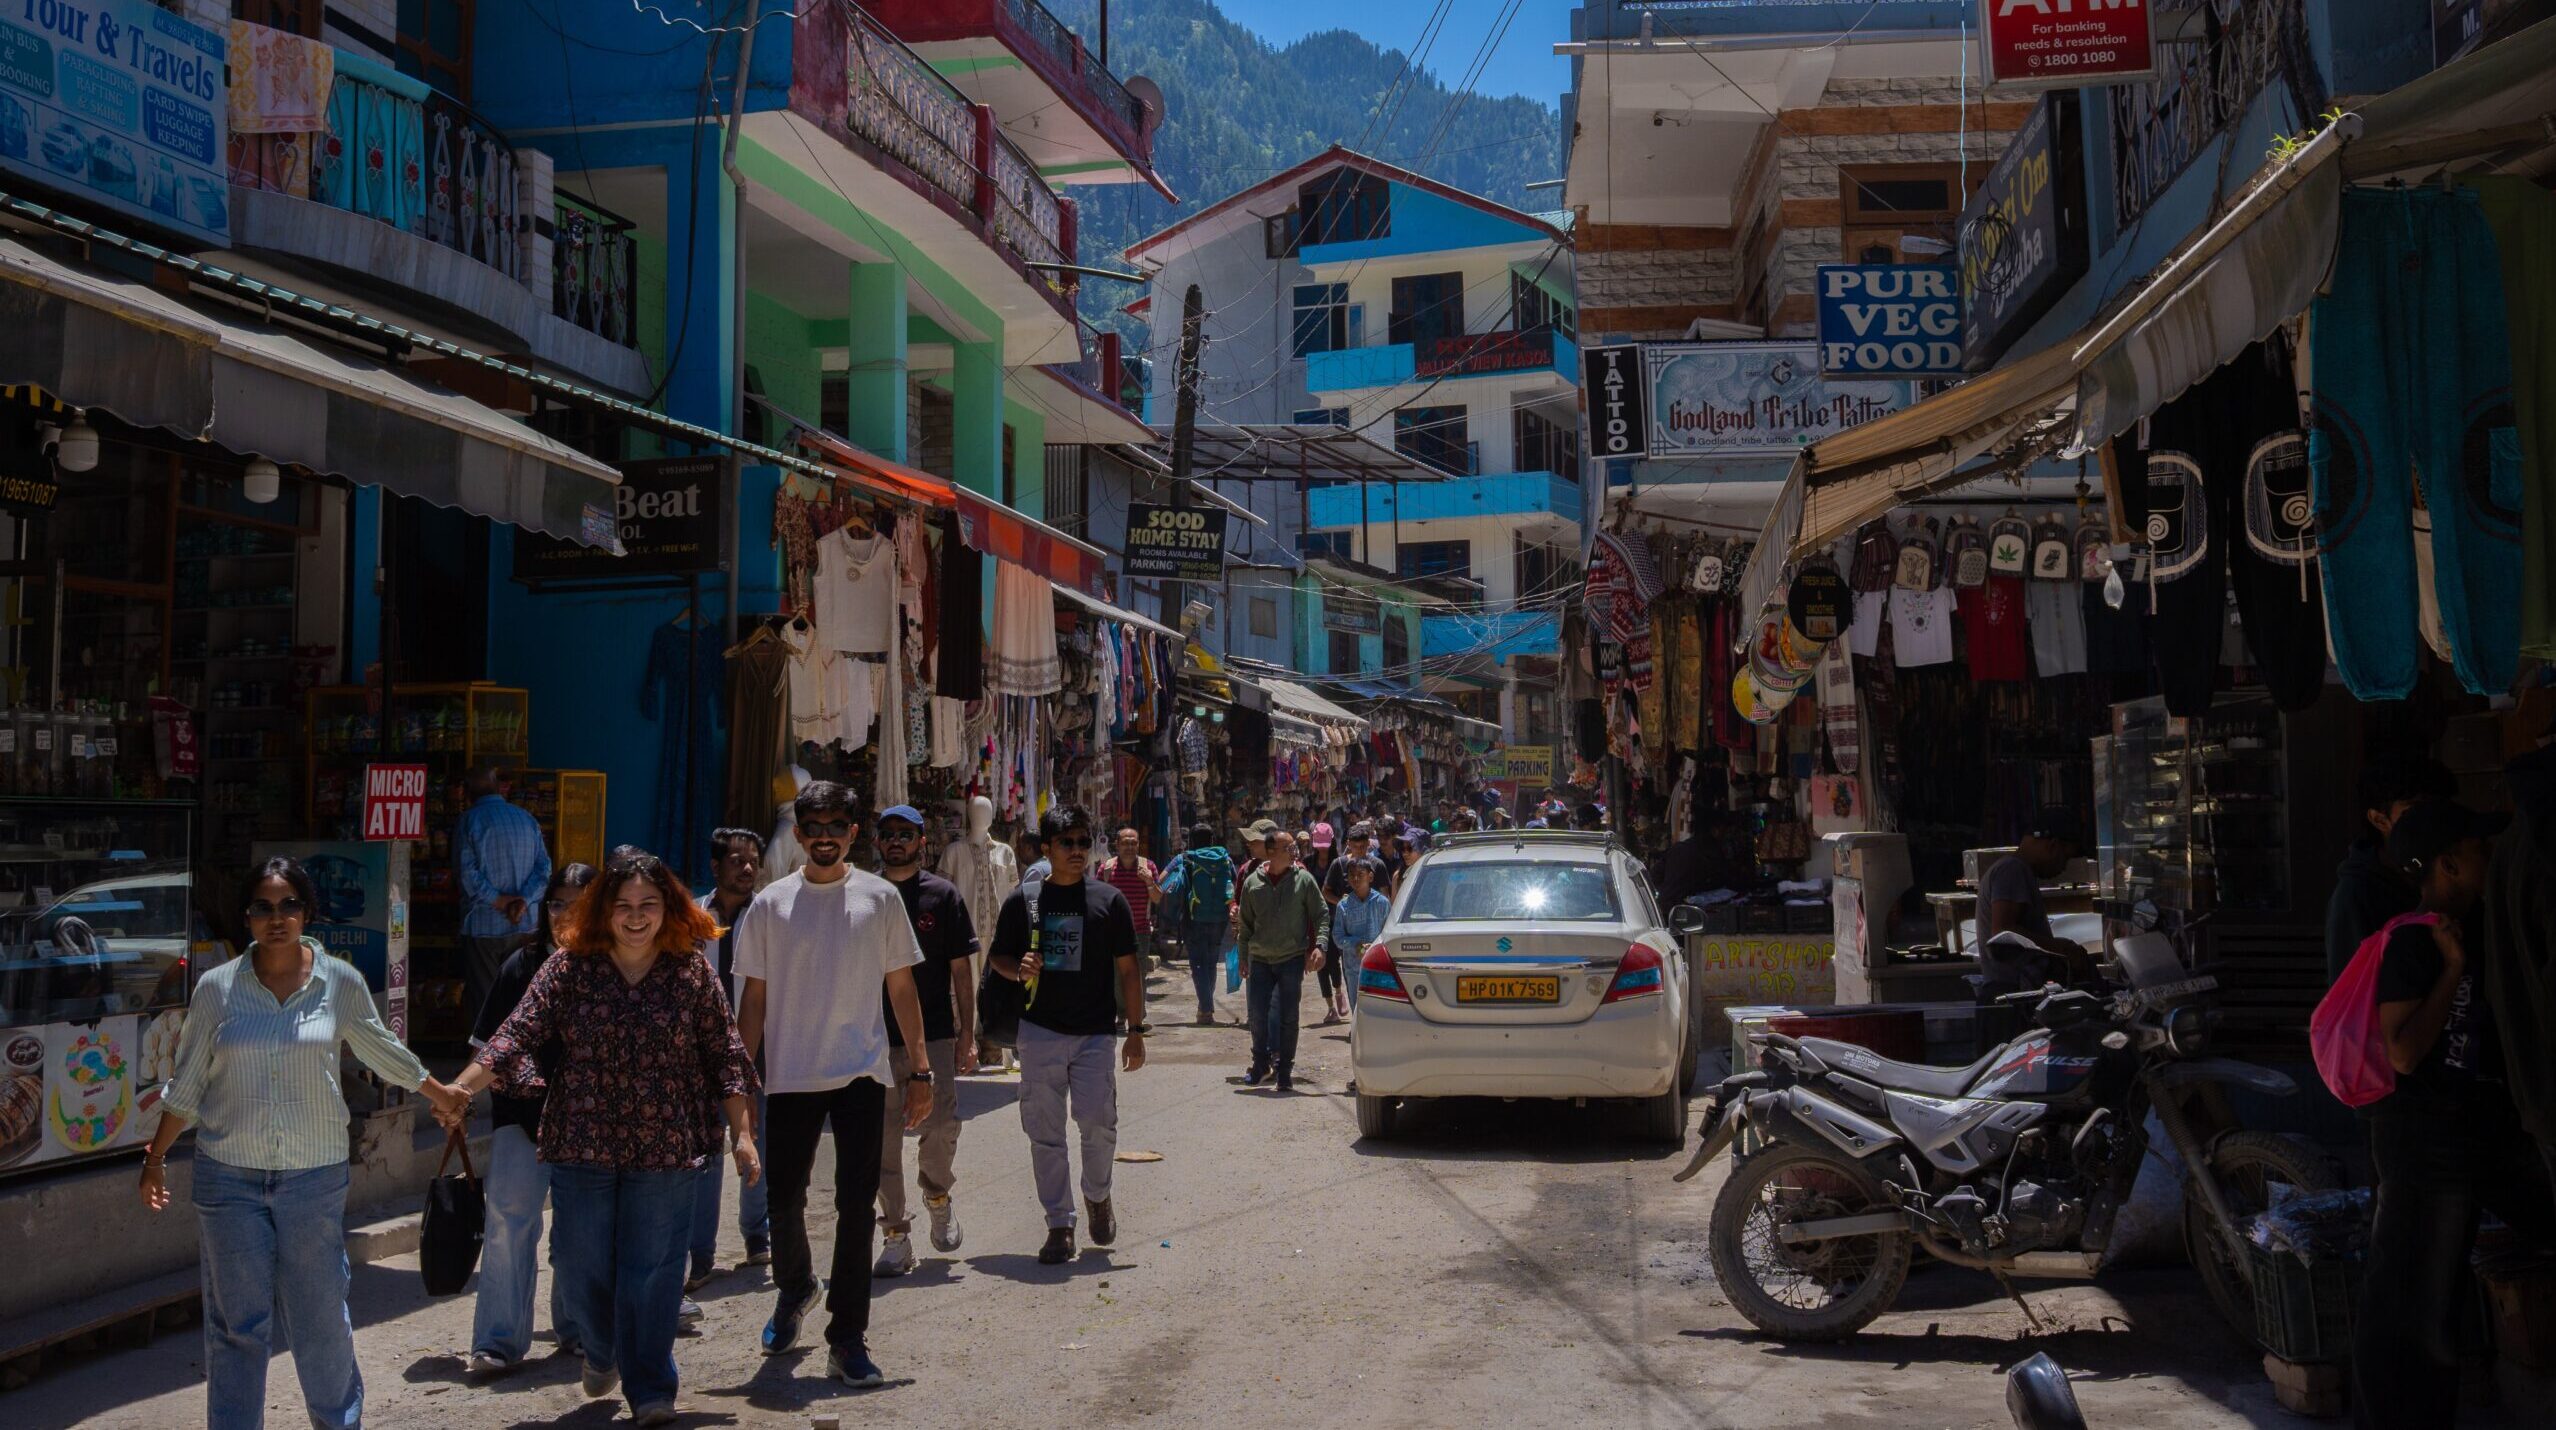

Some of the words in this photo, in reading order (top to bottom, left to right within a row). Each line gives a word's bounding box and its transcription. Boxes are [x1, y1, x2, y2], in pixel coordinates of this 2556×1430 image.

[0, 24, 14, 42] IN
[16, 32, 39, 53] BUS
[2032, 24, 2053, 35] For
[2056, 21, 2106, 34] banking
[4, 46, 16, 63] &
[96, 12, 119, 58] &
[128, 25, 214, 101] Travels
[2014, 39, 2050, 51] needs
[2054, 38, 2064, 48] &
[2065, 35, 2127, 48] resolution
[2044, 54, 2079, 67] 1800
[2082, 51, 2116, 64] 1080
[0, 63, 51, 95] BOOKING
[63, 52, 135, 96] PARAGLIDING
[76, 77, 124, 107] RAFTING
[90, 100, 126, 127] SKIING
[147, 89, 176, 114] CARD
[178, 102, 213, 128] SWIPE
[155, 110, 206, 143] LUGGAGE
[158, 130, 204, 159] KEEPING
[2020, 148, 2048, 216] Om
[1839, 303, 1961, 337] VEG
[1470, 354, 1503, 371] VIEW
[1825, 341, 1962, 371] FOOD
[1602, 351, 1629, 452] TATTOO
[1669, 400, 1756, 436] Godland
[1763, 394, 1830, 429] Tribe
[0, 474, 58, 508] 19651087
[616, 484, 702, 520] Beat
[1148, 510, 1206, 530] SOOD
[661, 544, 678, 553] FREE
[1130, 528, 1176, 547] HOME
[1179, 531, 1220, 549] STAY
[1131, 559, 1173, 570] PARKING
[1140, 548, 1167, 557] ROOMS
[1168, 550, 1208, 560] AVAILABLE
[1508, 760, 1549, 777] PARKING
[370, 769, 425, 798] MICRO
[368, 802, 421, 835] ATM
[331, 929, 368, 945] DELHI
[1044, 931, 1080, 942] ENE
[1044, 945, 1079, 955] RGY
[1519, 982, 1555, 997] 7569
